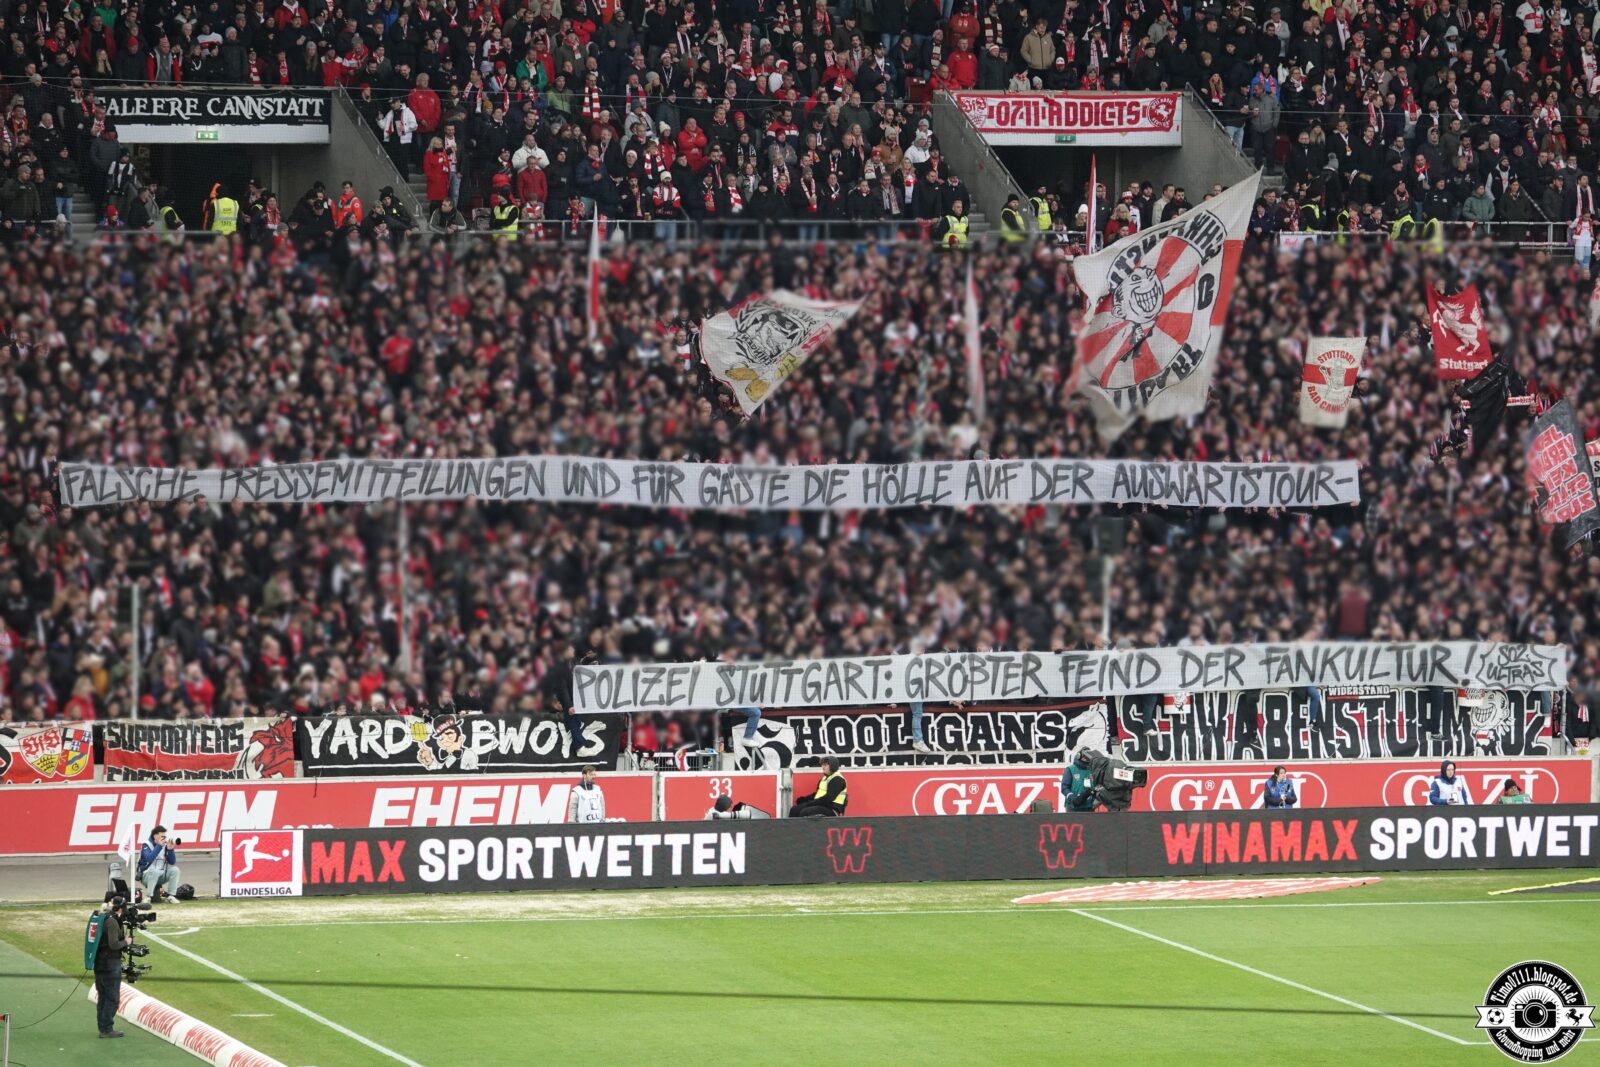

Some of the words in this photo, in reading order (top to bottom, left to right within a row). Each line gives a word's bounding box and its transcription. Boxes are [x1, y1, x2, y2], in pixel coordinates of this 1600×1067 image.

[206, 96, 324, 120] CANNSTATT
[1439, 358, 1488, 371] Stuttgart
[1307, 385, 1322, 404] BAD
[62, 464, 200, 501] FALSCHE
[220, 459, 547, 500] PRESSEMITTEILUNGEN
[562, 459, 621, 498] UND
[631, 463, 686, 503] FÜR
[699, 464, 790, 507] GÄSTE
[804, 468, 849, 507] DIE
[862, 462, 953, 505] HÖLLE
[964, 461, 1024, 501] AUF
[1029, 461, 1095, 501] DER
[573, 665, 701, 710] POLIZEI
[1058, 652, 1162, 695] FEIND
[1177, 648, 1246, 689] DER
[1328, 685, 1391, 696] WIDERSTAND
[106, 720, 245, 755] SUPPORTERS
[303, 717, 412, 760] YARD
[787, 712, 1068, 756] HOOLIGANS
[369, 783, 572, 828] EHEIM
[708, 777, 733, 799] 33
[69, 790, 278, 850] EHEIM
[418, 831, 746, 882] SPORTWETTEN
[1161, 819, 1359, 865] WINAMAX
[230, 887, 293, 896] BUNDESLIGA
